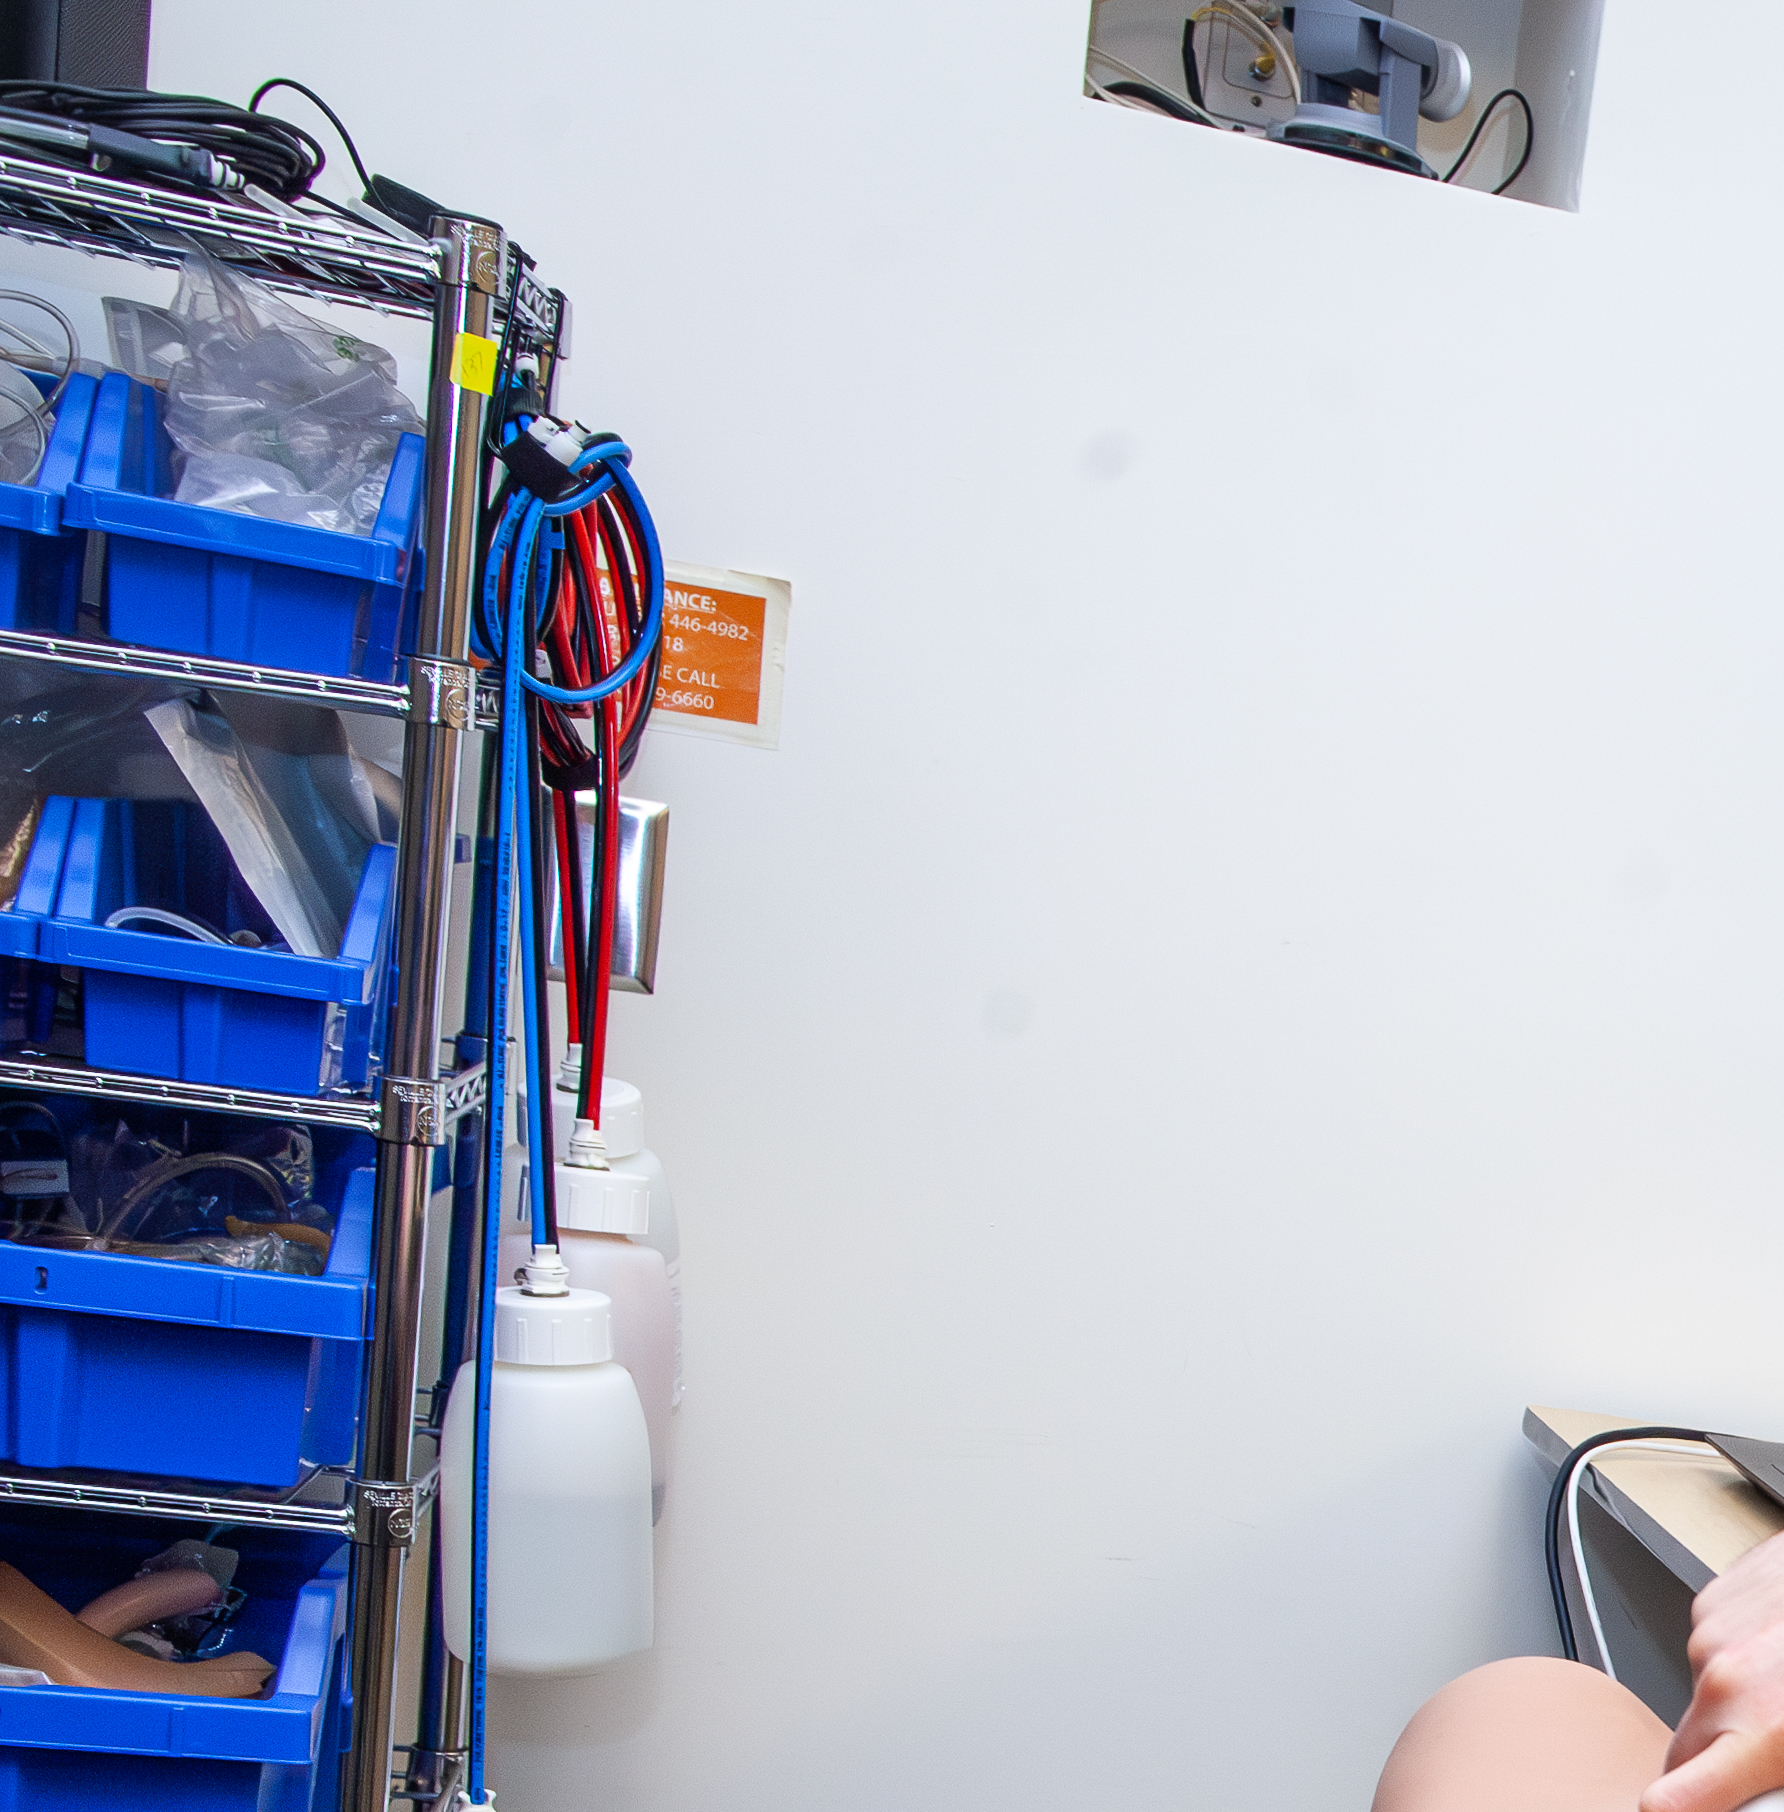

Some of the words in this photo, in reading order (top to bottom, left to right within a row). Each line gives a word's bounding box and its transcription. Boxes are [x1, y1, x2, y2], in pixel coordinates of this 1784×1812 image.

[663, 588, 717, 612] ANCE:
[669, 613, 749, 641] 446-4982
[663, 635, 684, 653] 18
[676, 667, 721, 689] CALL
[655, 687, 714, 711] 9-6660
